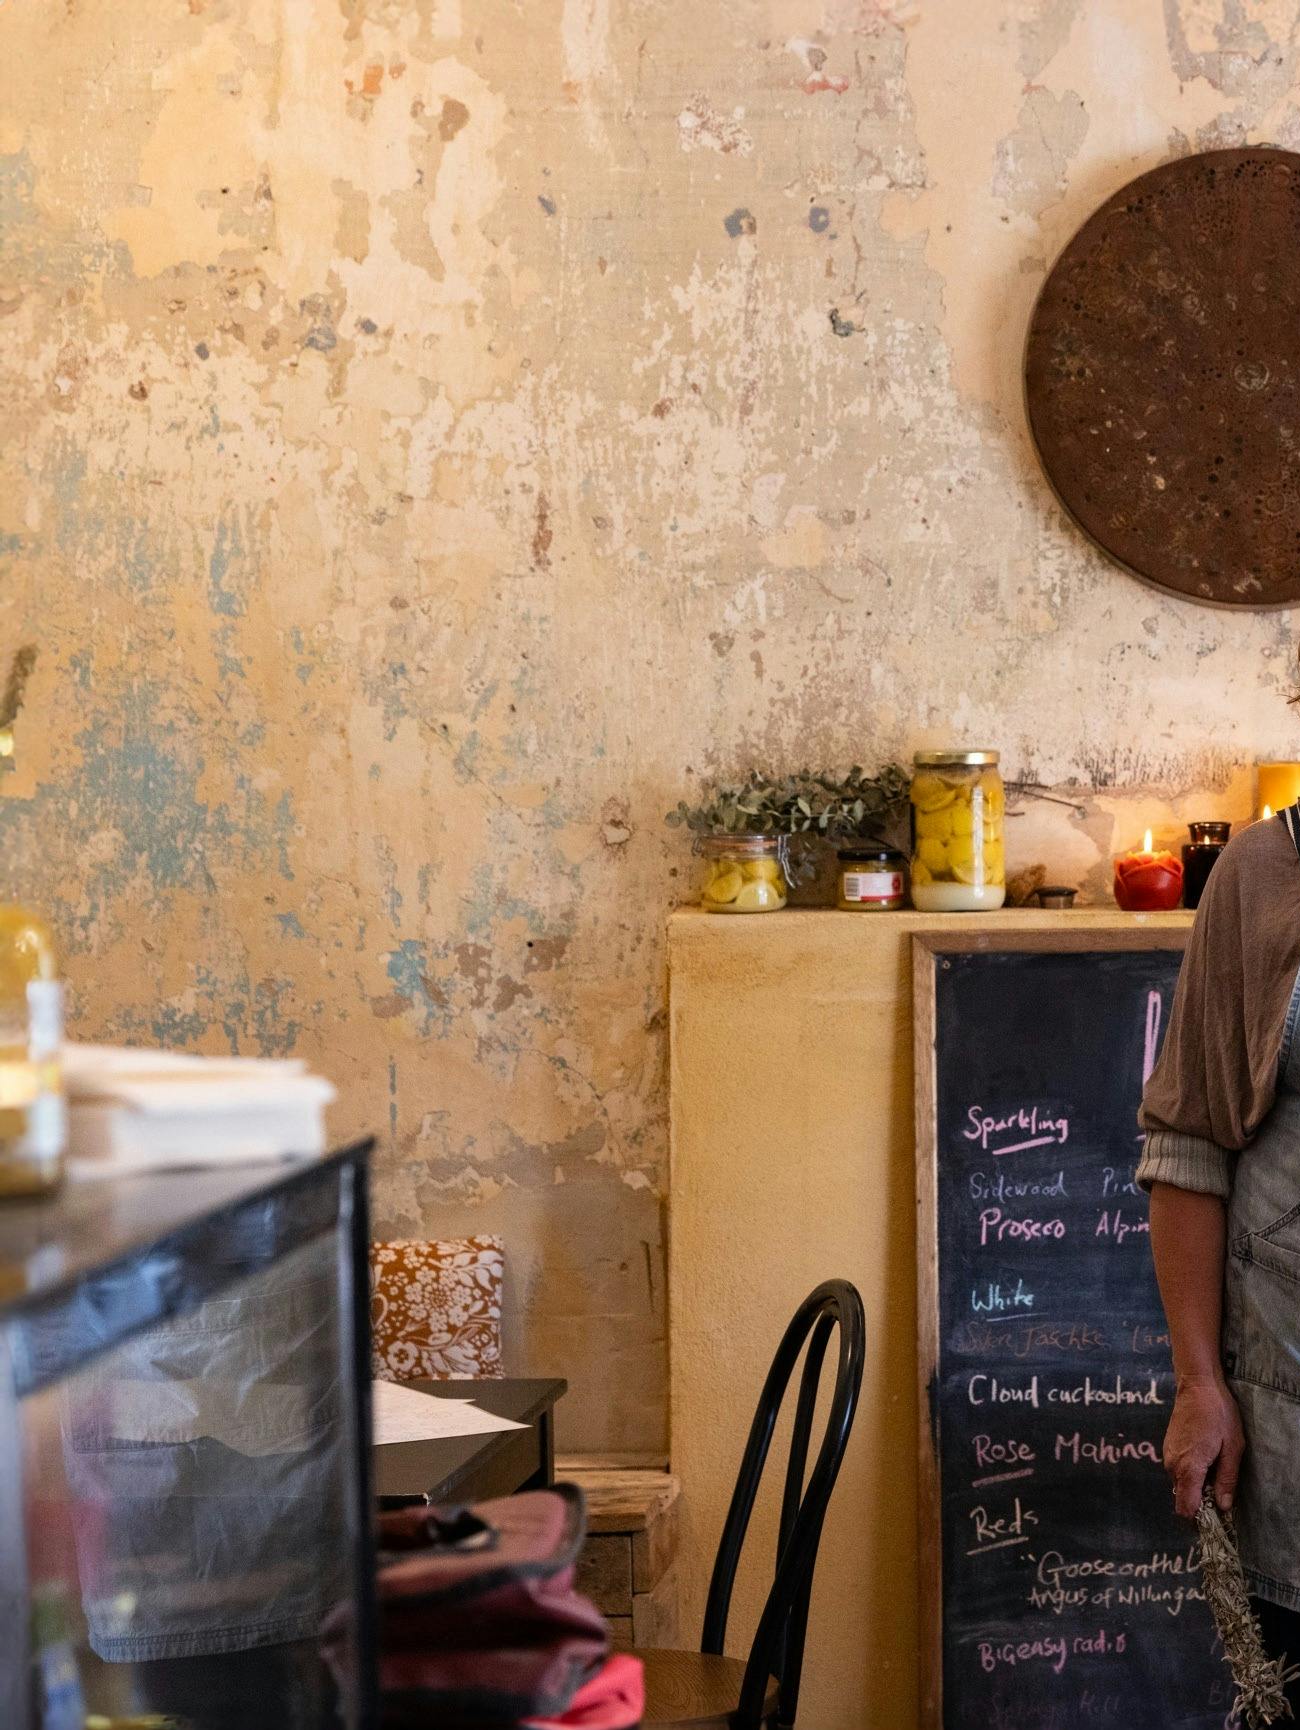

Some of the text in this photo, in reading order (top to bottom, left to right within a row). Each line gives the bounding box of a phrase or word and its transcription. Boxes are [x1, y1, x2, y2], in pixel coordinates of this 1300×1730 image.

[963, 1106, 1069, 1149] Sparkling
[970, 1171, 1069, 1204] Sidewood
[971, 1278, 1036, 1312] White
[968, 1374, 1039, 1408] Cloud
[971, 1434, 1036, 1467] Rose
[969, 1497, 1039, 1542] Reds
[1092, 1586, 1116, 1609] of
